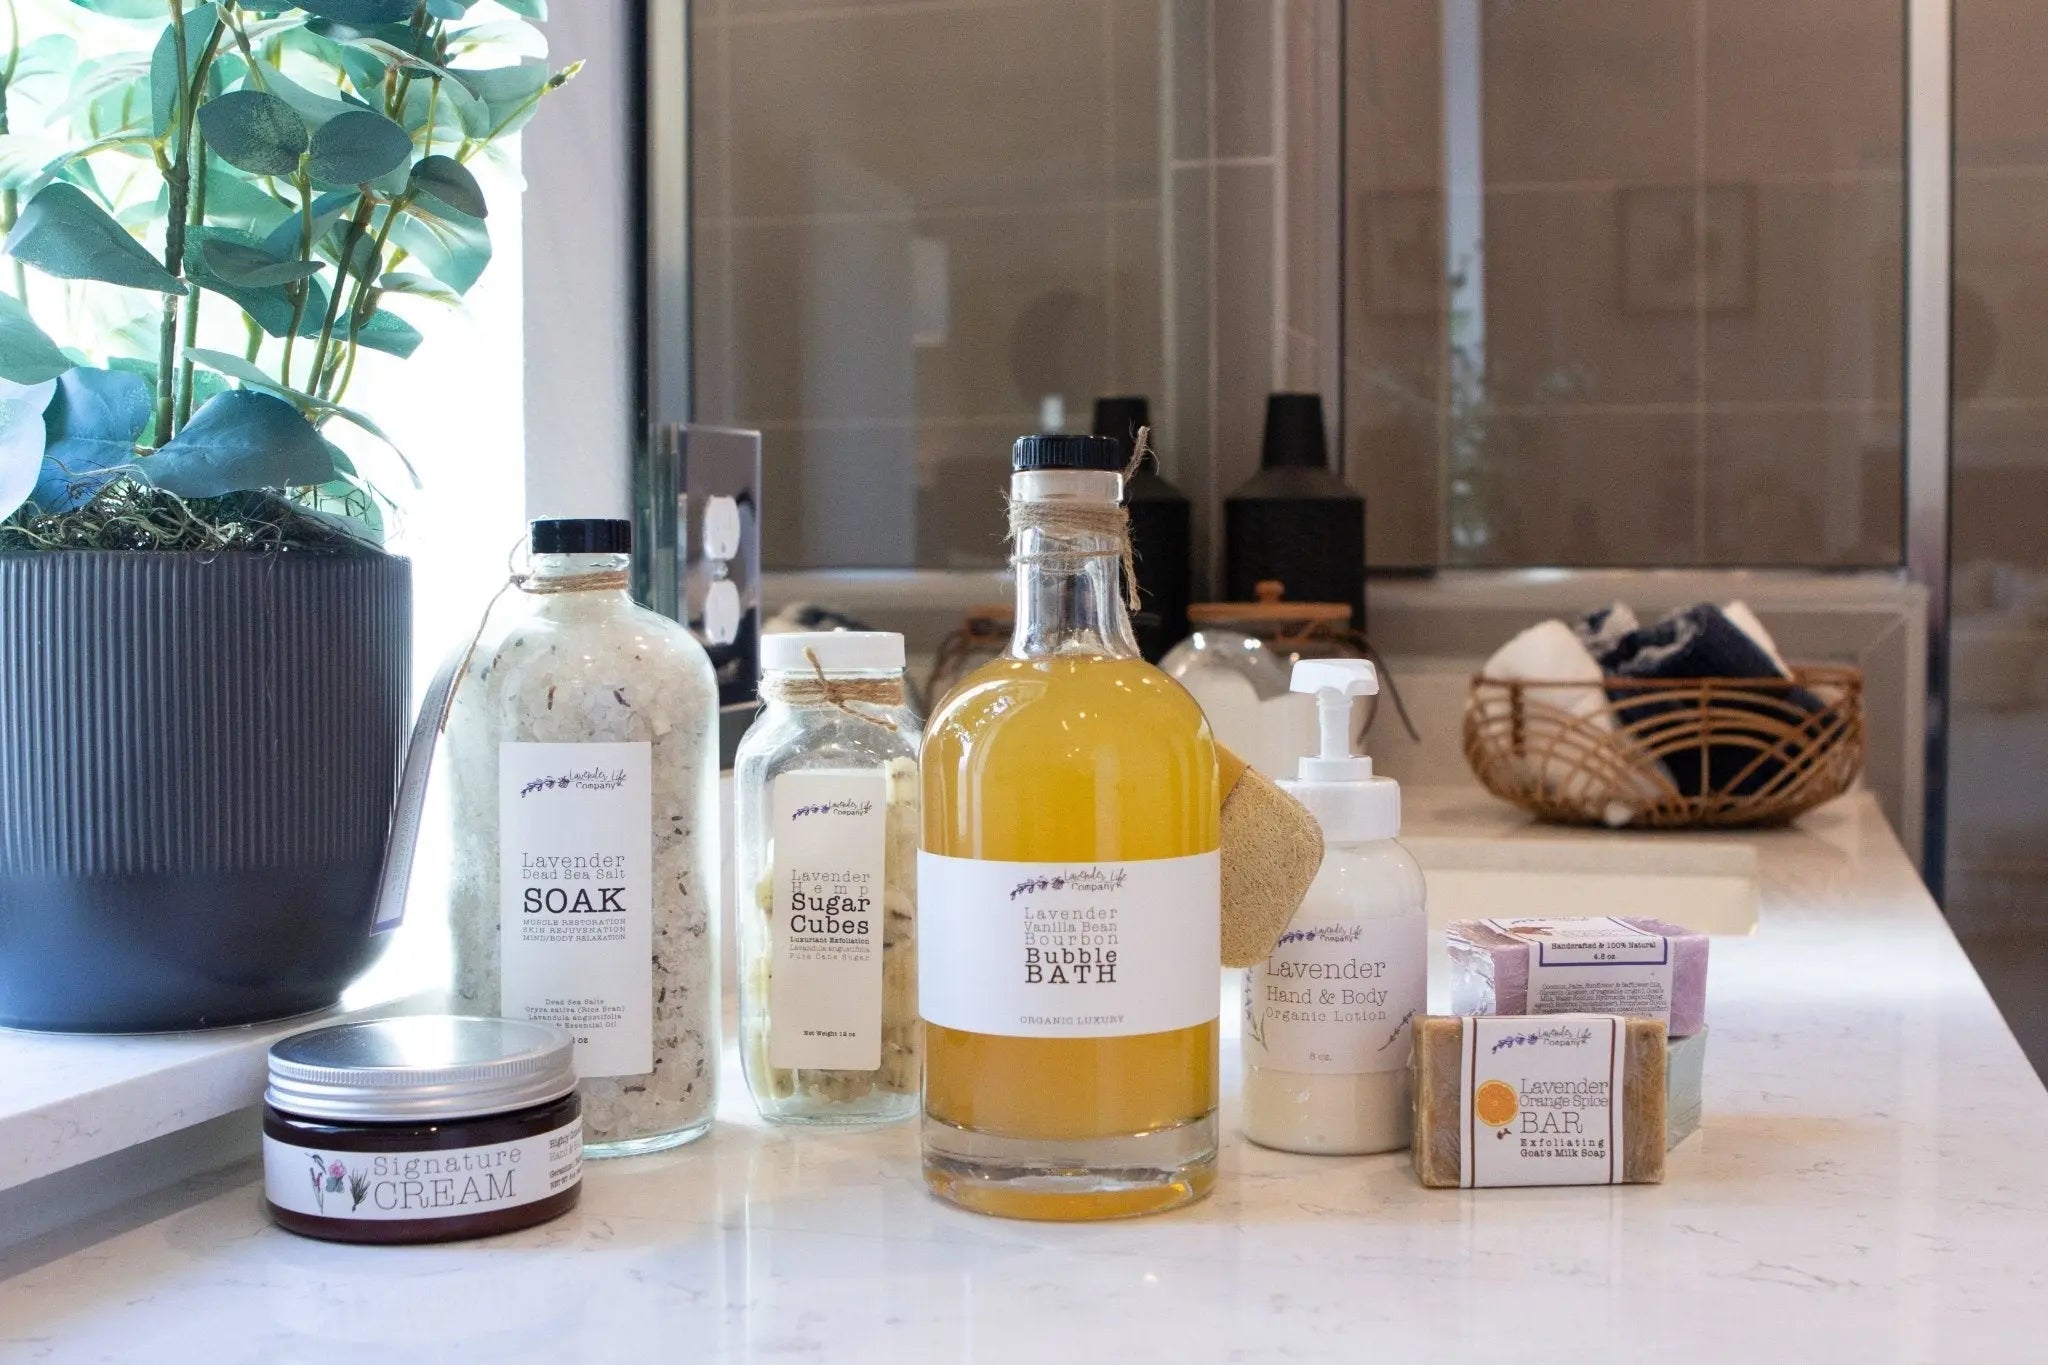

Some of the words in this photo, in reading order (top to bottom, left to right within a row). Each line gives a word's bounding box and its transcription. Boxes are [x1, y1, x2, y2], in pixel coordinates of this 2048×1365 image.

[569, 766, 609, 781] Lavender
[612, 768, 627, 783] Life
[575, 782, 616, 791] Company
[833, 808, 864, 817] Company
[522, 852, 625, 868] Lavender
[523, 868, 558, 880] Dead
[564, 868, 591, 880] Sea
[596, 868, 626, 880] Salt
[791, 869, 870, 883] Lavender
[1064, 866, 1106, 882] Lavender
[1110, 868, 1128, 883] Life
[1071, 882, 1115, 893] Company
[523, 887, 627, 914] SOAK
[791, 892, 871, 915] Sugar
[1024, 906, 1119, 921] Lavender
[562, 918, 626, 926] RESTORATION
[790, 914, 869, 935] Cubes
[1024, 921, 1077, 933] Vanilla
[1082, 921, 1118, 933] Bean
[550, 926, 626, 934] REJUVENATION
[522, 935, 573, 943] MIND/BODY
[576, 934, 626, 942] RELAXATION
[1024, 932, 1119, 946] Bourbon
[1320, 934, 1354, 943] Company
[1551, 942, 1597, 950] Handcrafted
[1628, 941, 1657, 949] Natural
[1025, 947, 1118, 965] Bubble
[1024, 964, 1118, 985] BATH
[1266, 956, 1387, 980] Lavender
[545, 998, 565, 1006] Dead
[567, 998, 582, 1006] Sea
[584, 997, 605, 1006] Salts
[1267, 985, 1312, 1005] Hand
[1319, 988, 1336, 1005] &
[1342, 987, 1389, 1007] Body
[528, 1013, 570, 1021] Lavandula
[1019, 1016, 1074, 1026] ORGANIC
[1077, 1015, 1125, 1026] LUXURY
[1265, 1007, 1326, 1022] Organic
[1334, 1009, 1387, 1022] Lotion
[564, 1020, 603, 1029] Essential
[605, 1019, 617, 1028] Oil
[1538, 1026, 1572, 1039] Lavender
[1577, 1028, 1592, 1039] Life
[577, 1036, 589, 1044] oz
[1544, 1039, 1581, 1047] Company
[1519, 1078, 1608, 1095] Lavender
[1519, 1094, 1569, 1110] Orange
[1572, 1094, 1608, 1110] Spice
[1519, 1111, 1584, 1134] BAR
[1520, 1138, 1605, 1148] Exfoliating
[1520, 1149, 1552, 1158] Goat's
[1555, 1149, 1578, 1158] Milk
[1581, 1148, 1606, 1160] Soap
[374, 1147, 522, 1180] Signature
[374, 1168, 518, 1211] CREAM
